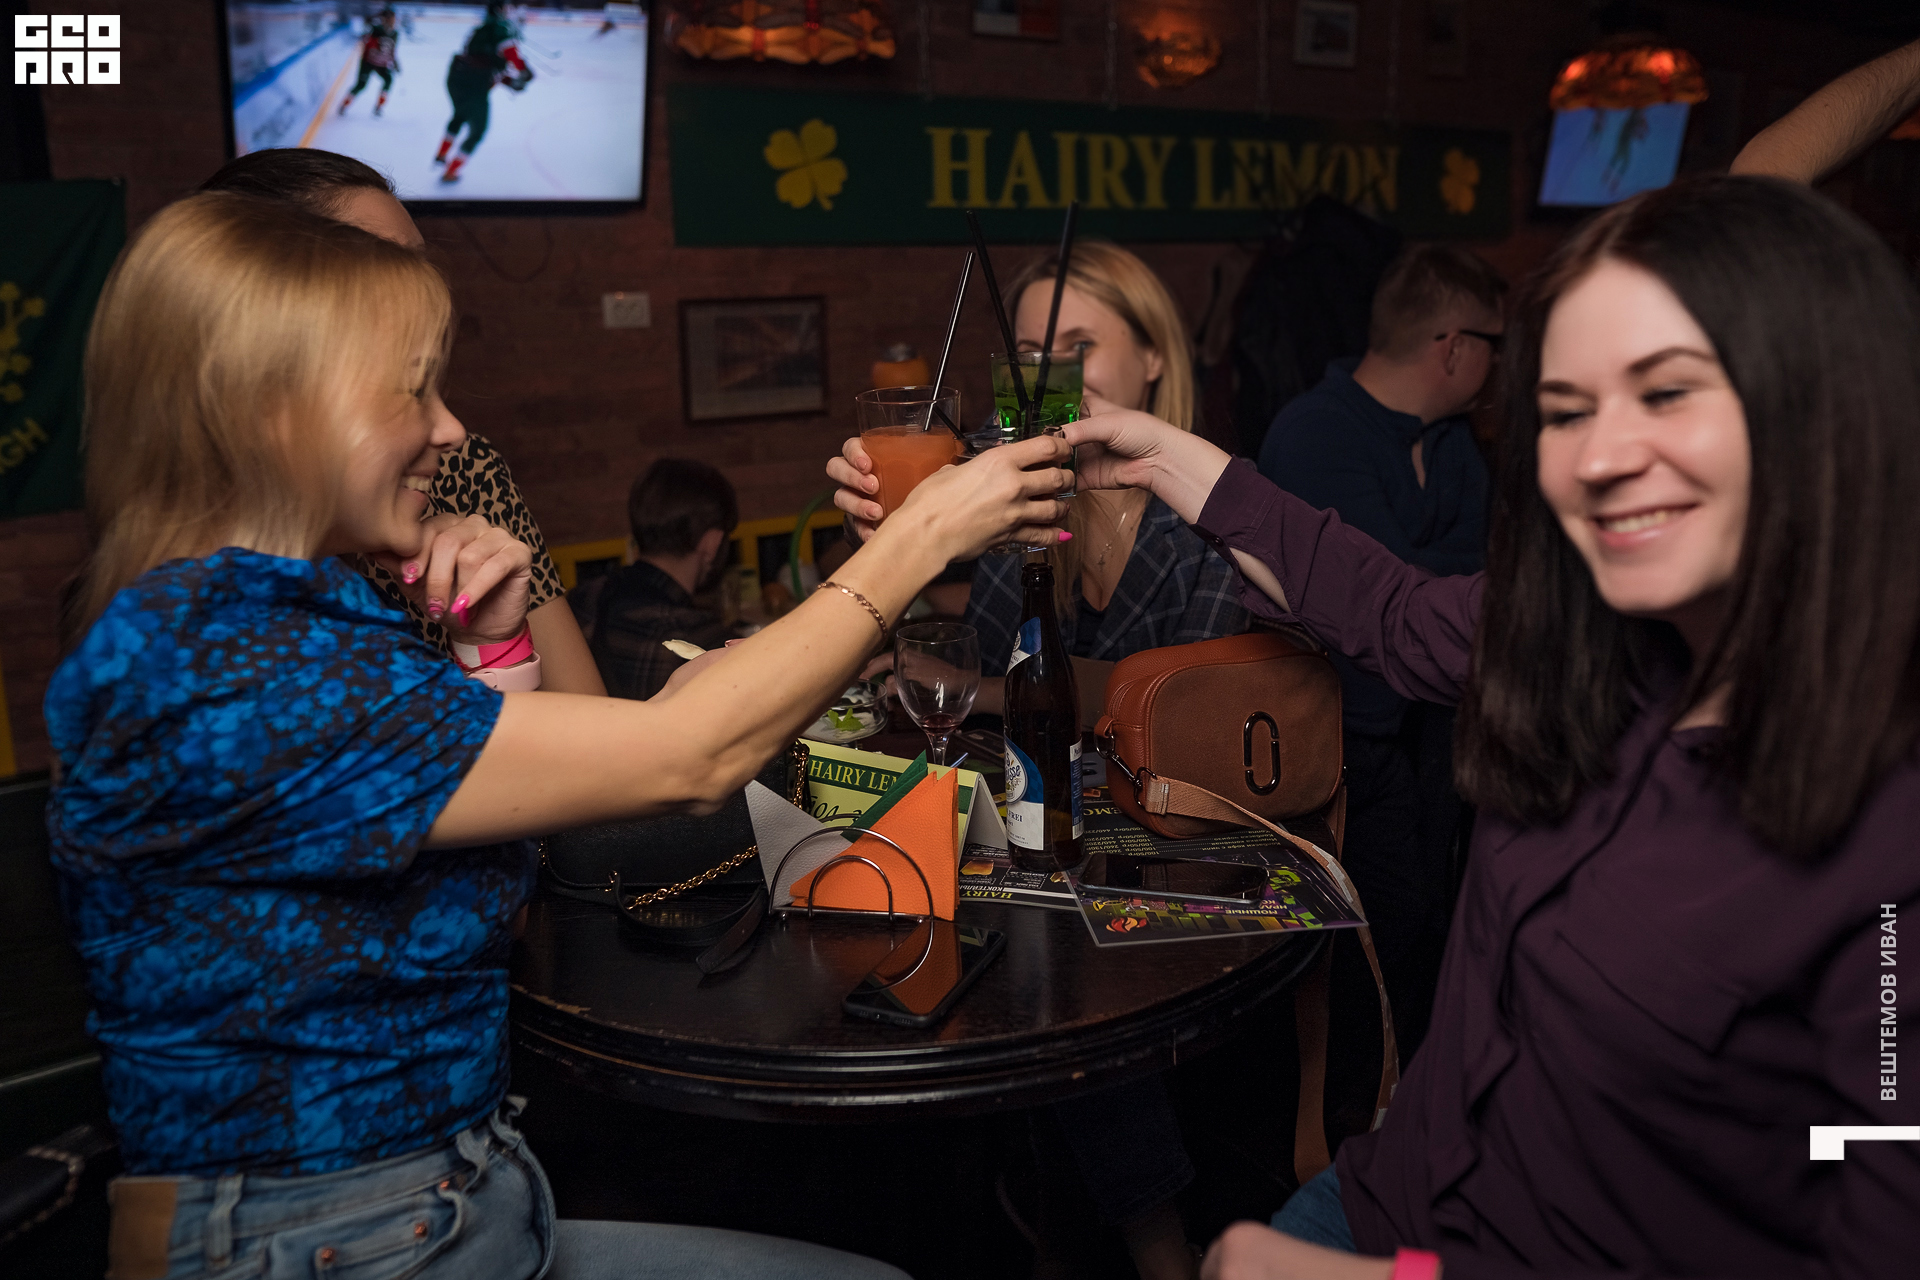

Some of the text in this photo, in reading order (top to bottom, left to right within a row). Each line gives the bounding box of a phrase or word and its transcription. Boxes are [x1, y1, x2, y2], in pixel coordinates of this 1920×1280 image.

[925, 126, 1402, 213] HAIRY LEMON
[809, 760, 866, 786] HAIRY
[1083, 807, 1123, 816] EMO
[961, 890, 1013, 899] HAIRY
